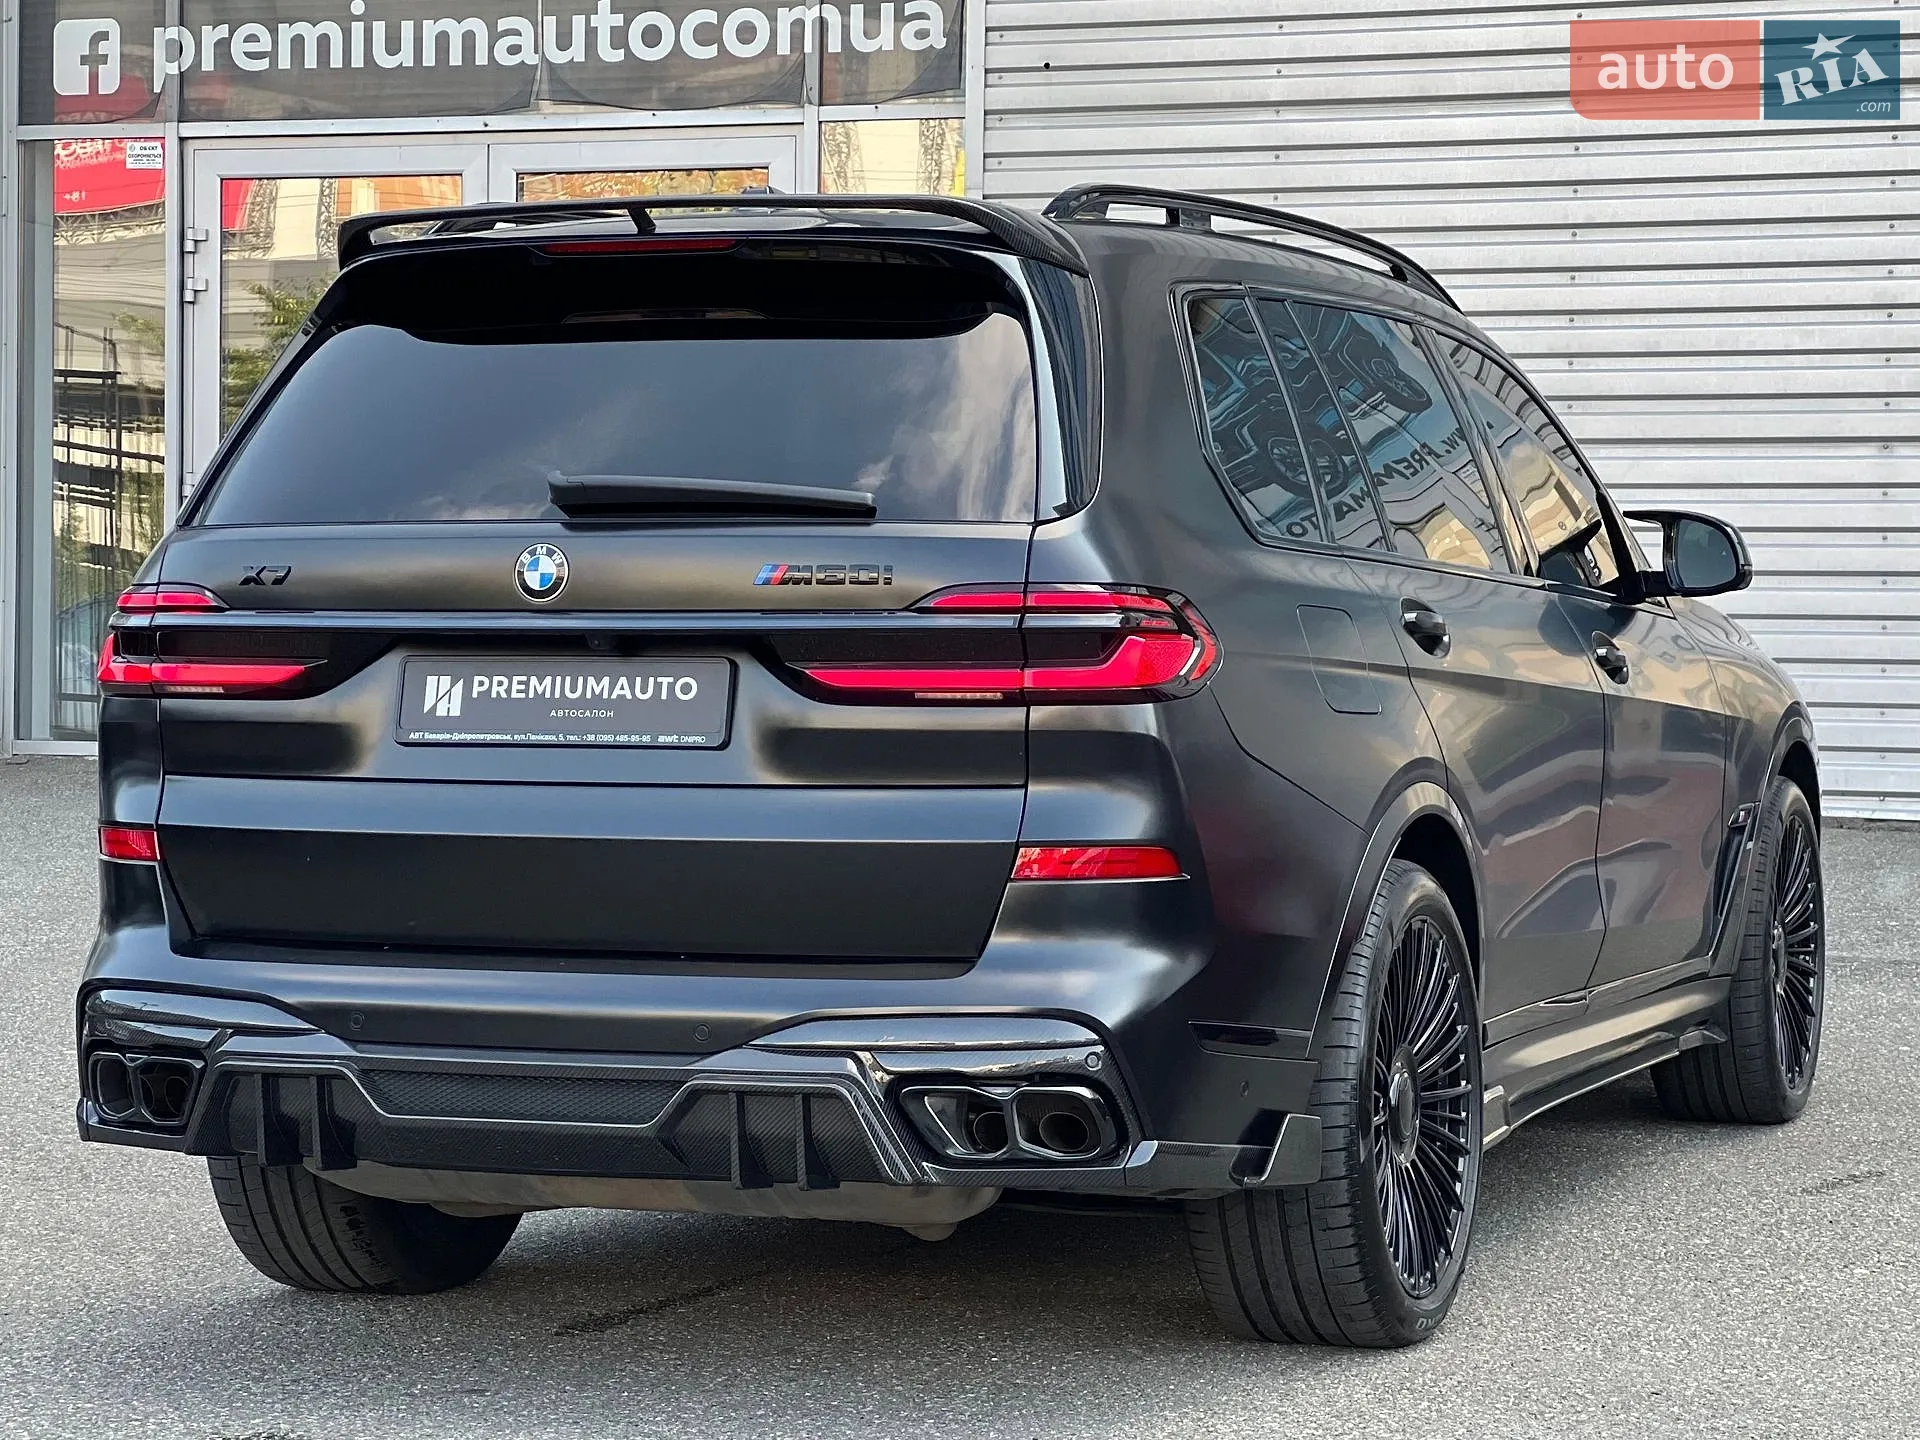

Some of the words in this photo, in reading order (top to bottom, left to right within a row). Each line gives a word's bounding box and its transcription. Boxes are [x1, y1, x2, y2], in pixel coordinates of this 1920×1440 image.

[154, 0, 947, 93] premiumautocomua
[520, 545, 563, 564] BMW
[238, 565, 292, 586] X7
[471, 675, 698, 701] PREMIUMAUTO
[549, 709, 615, 718] АВТОСАЛОН
[582, 734, 596, 742] +38
[596, 734, 615, 744] (095)
[615, 734, 651, 743] 485-95-95
[680, 735, 706, 744] DNIPRO
